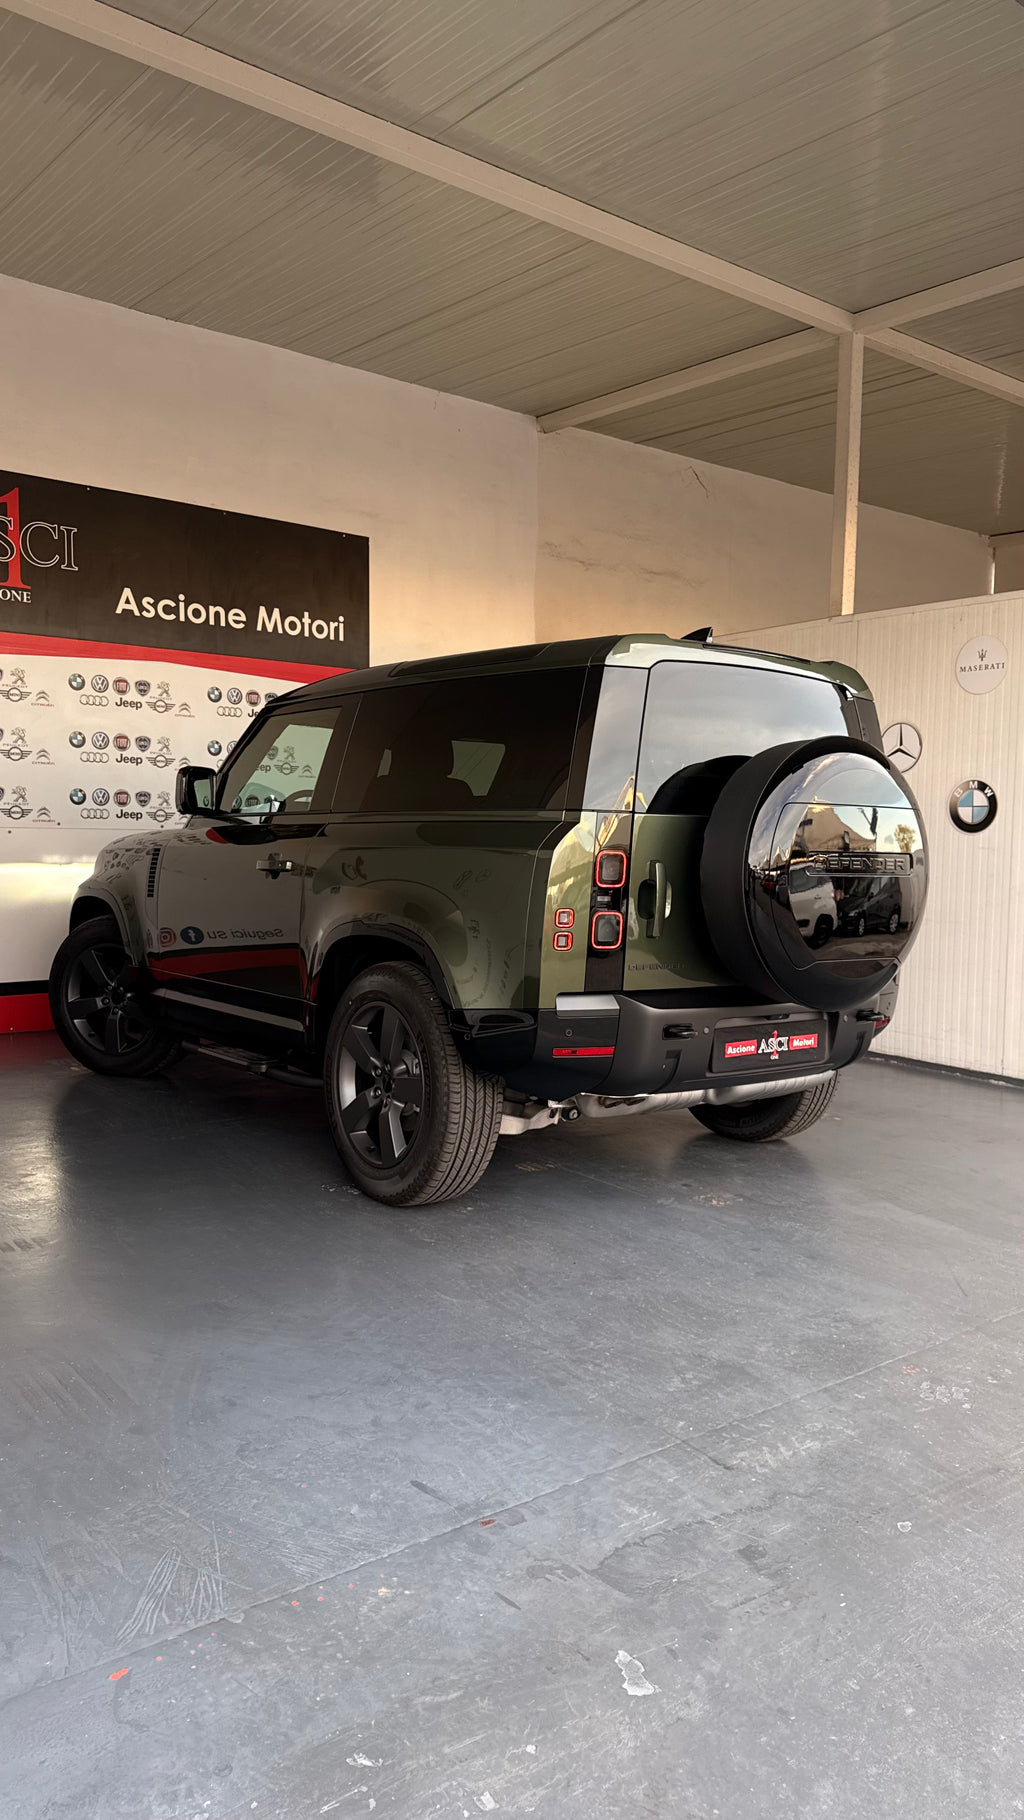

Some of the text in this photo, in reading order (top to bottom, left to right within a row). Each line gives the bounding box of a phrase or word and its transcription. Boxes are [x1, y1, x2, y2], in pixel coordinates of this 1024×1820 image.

[115, 587, 345, 641] Ascione Motori
[959, 662, 1005, 673] MASERATI
[115, 697, 143, 710] Jeep
[116, 753, 143, 766] Jeep
[954, 780, 993, 798] BMW
[116, 809, 143, 821] Jeep
[727, 1036, 815, 1055] Ascione ASCI Motori
